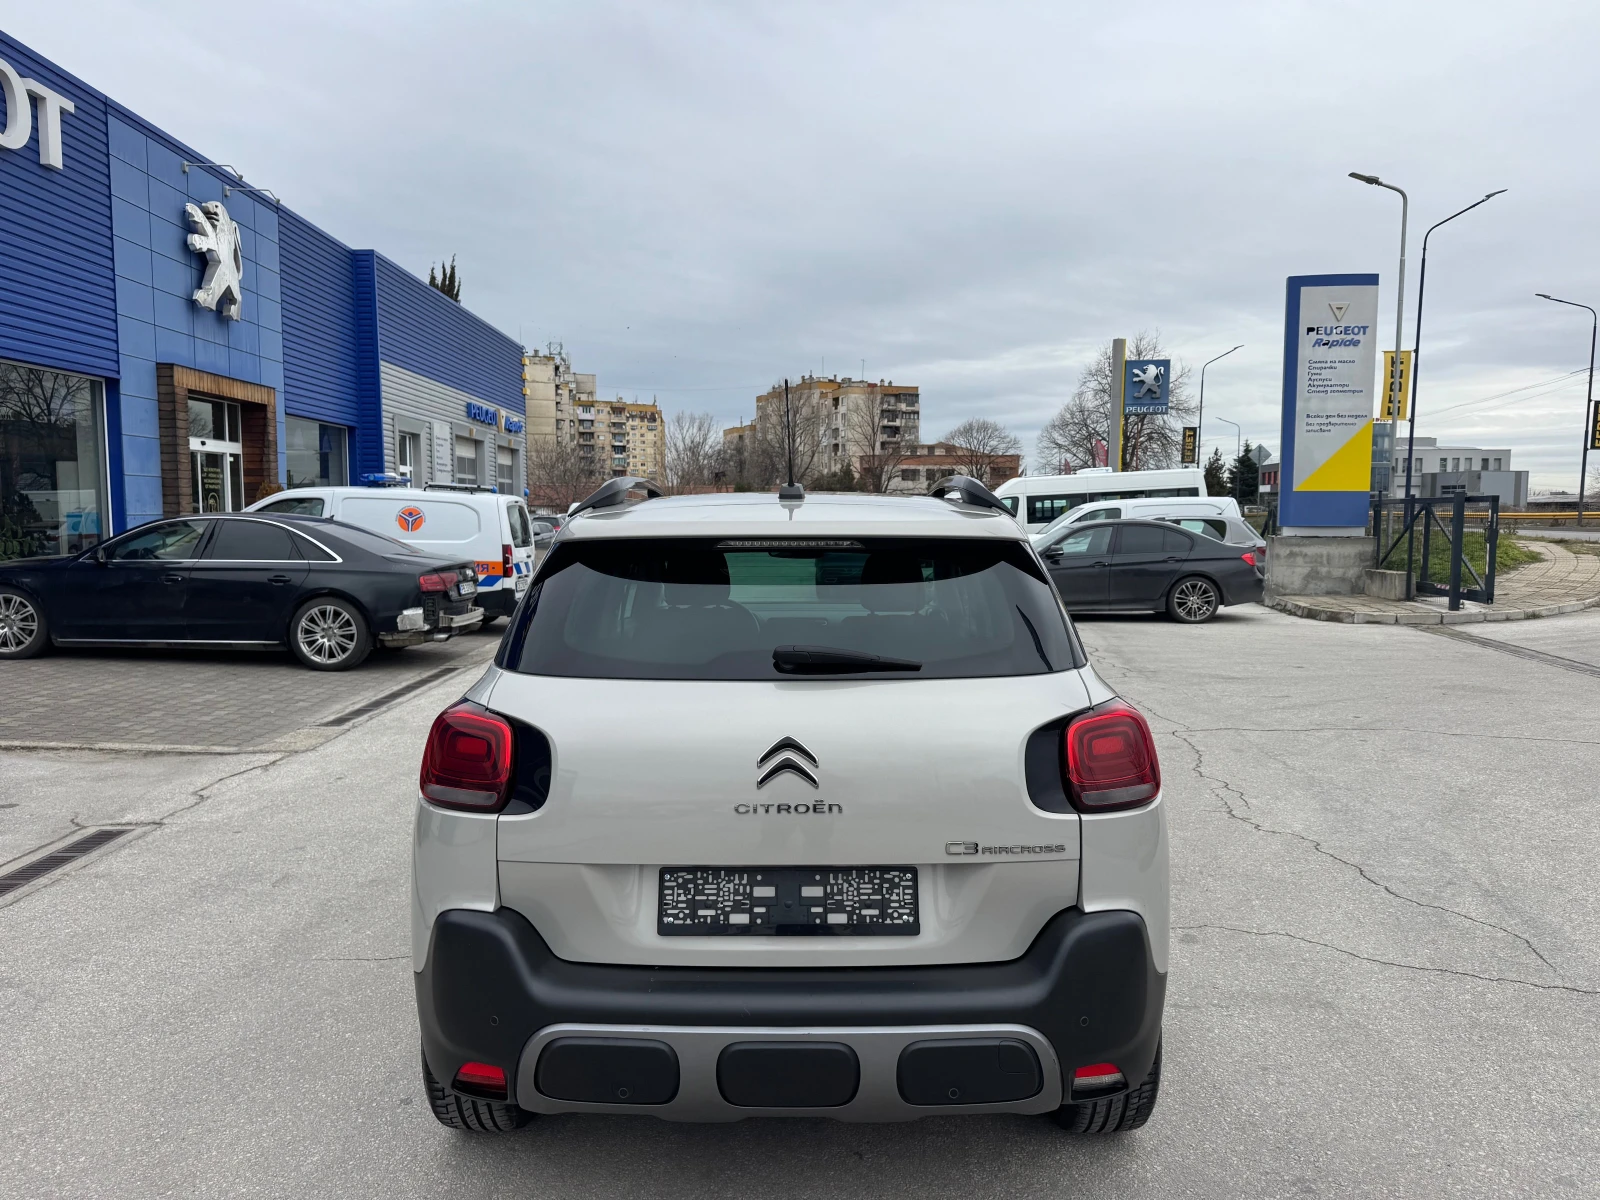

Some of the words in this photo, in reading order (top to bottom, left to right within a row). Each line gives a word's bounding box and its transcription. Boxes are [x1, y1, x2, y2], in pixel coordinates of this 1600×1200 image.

[1306, 325, 1369, 336] PEUGEOT
[1312, 337, 1361, 349] Rapide
[1125, 405, 1167, 413] PEUGEOT
[945, 841, 979, 855] C3
[981, 844, 1066, 855] AIRCROSS
